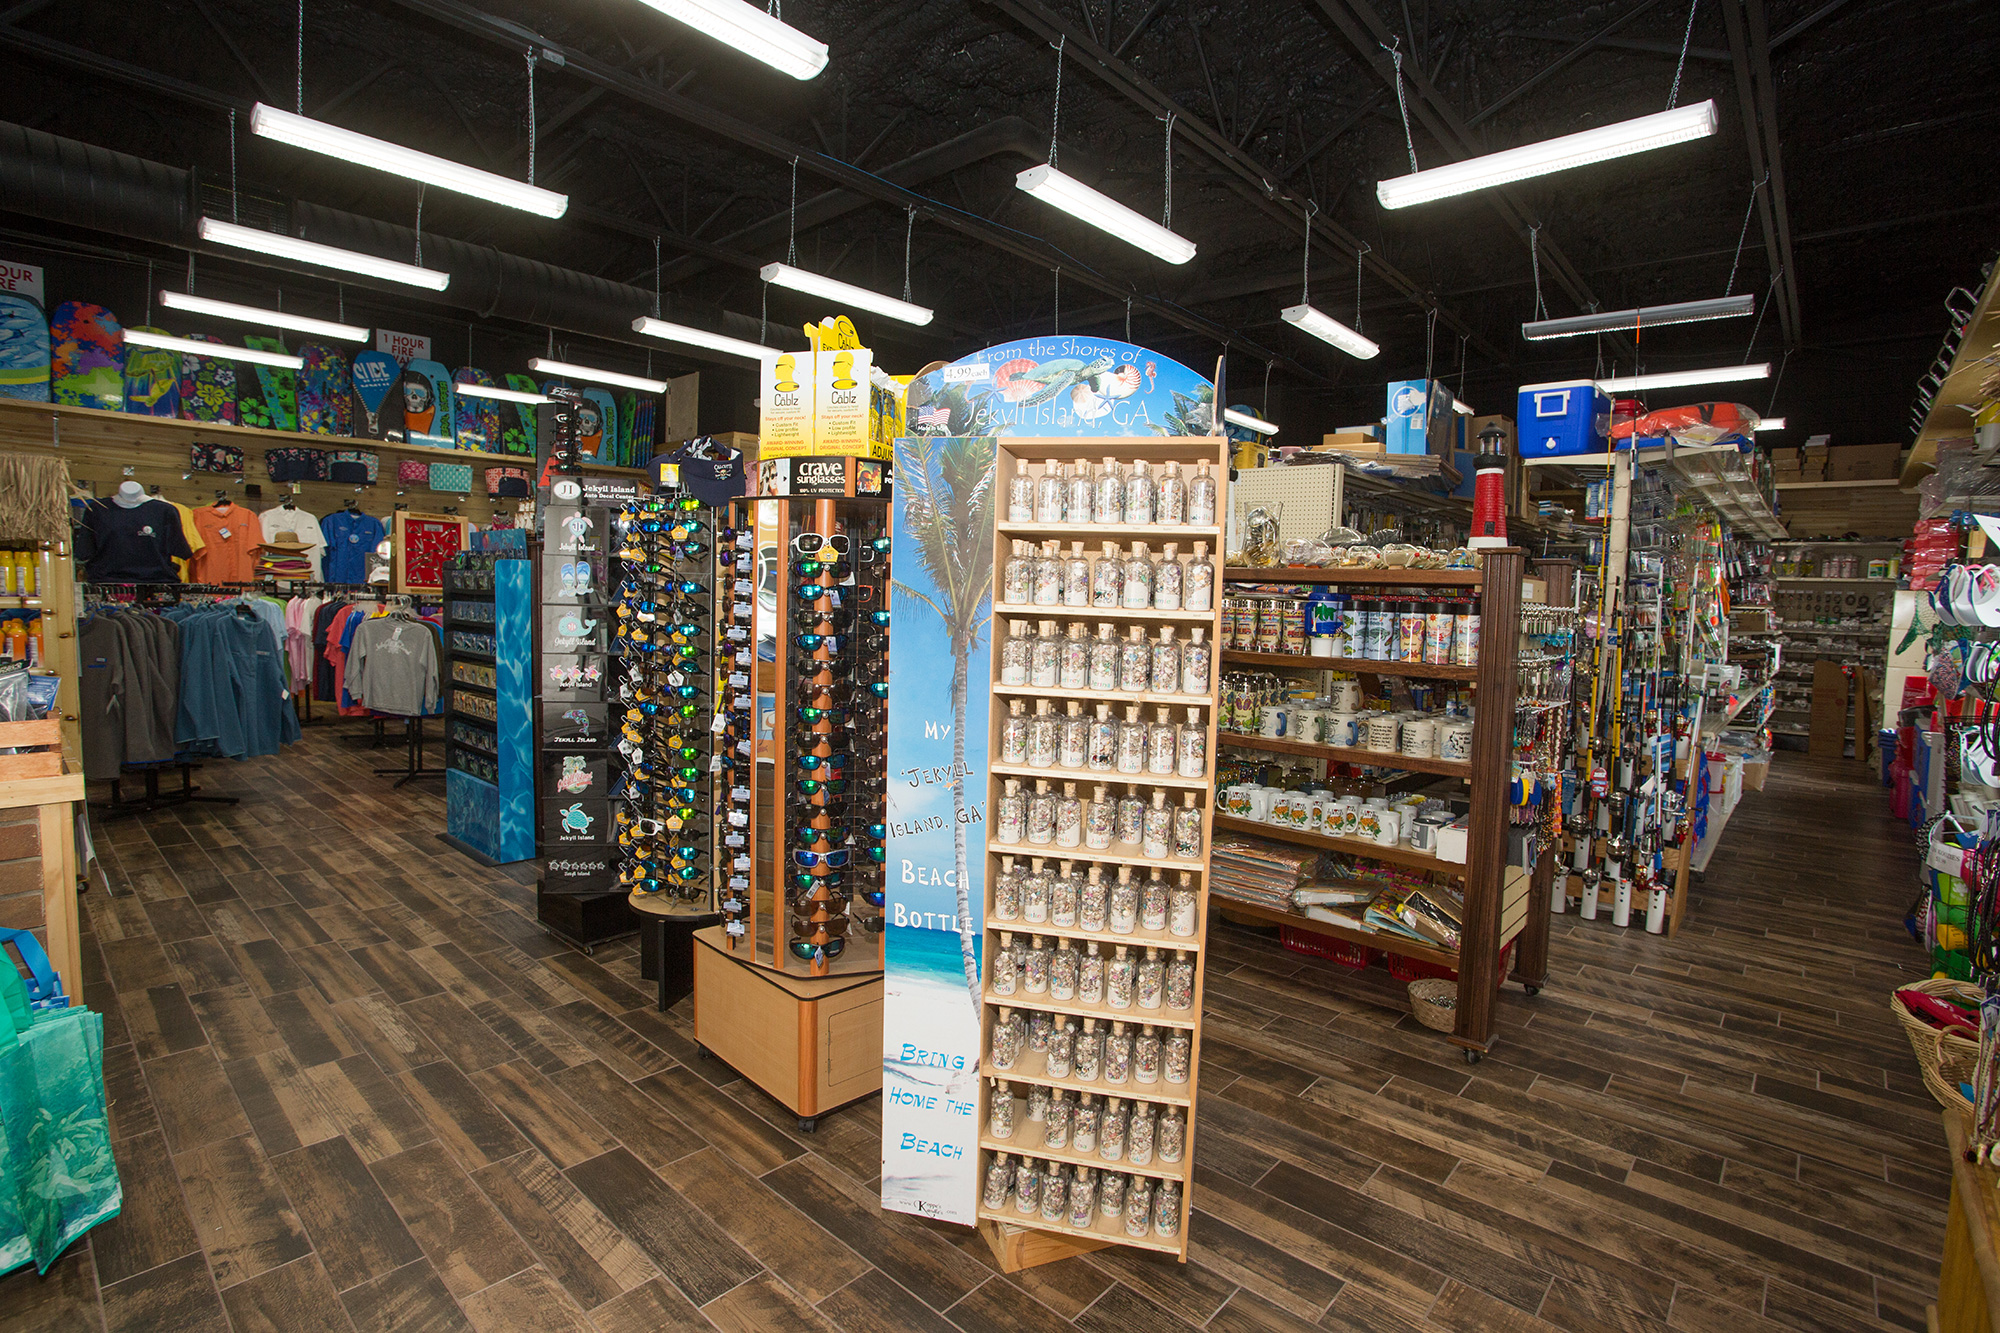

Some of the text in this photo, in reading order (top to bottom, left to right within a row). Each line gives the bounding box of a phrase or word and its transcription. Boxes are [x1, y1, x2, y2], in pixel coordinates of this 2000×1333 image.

[384, 334, 424, 349] 1 HOUR
[392, 345, 414, 357] FIRE
[976, 339, 1145, 364] From the Shores of
[964, 396, 1150, 435] Jekyll Island, GA
[799, 462, 843, 476] crave
[797, 475, 845, 485] sunglasses
[561, 485, 573, 495] JI
[582, 484, 608, 493] Jekyll
[559, 542, 595, 551] Jekyll Island
[554, 637, 575, 648] Jekyll
[901, 859, 970, 891] BEACH
[894, 902, 976, 935] BOTTLE
[900, 1043, 965, 1070] BRING
[889, 1086, 975, 1116] HOME THE
[900, 1132, 964, 1160] BEACH
